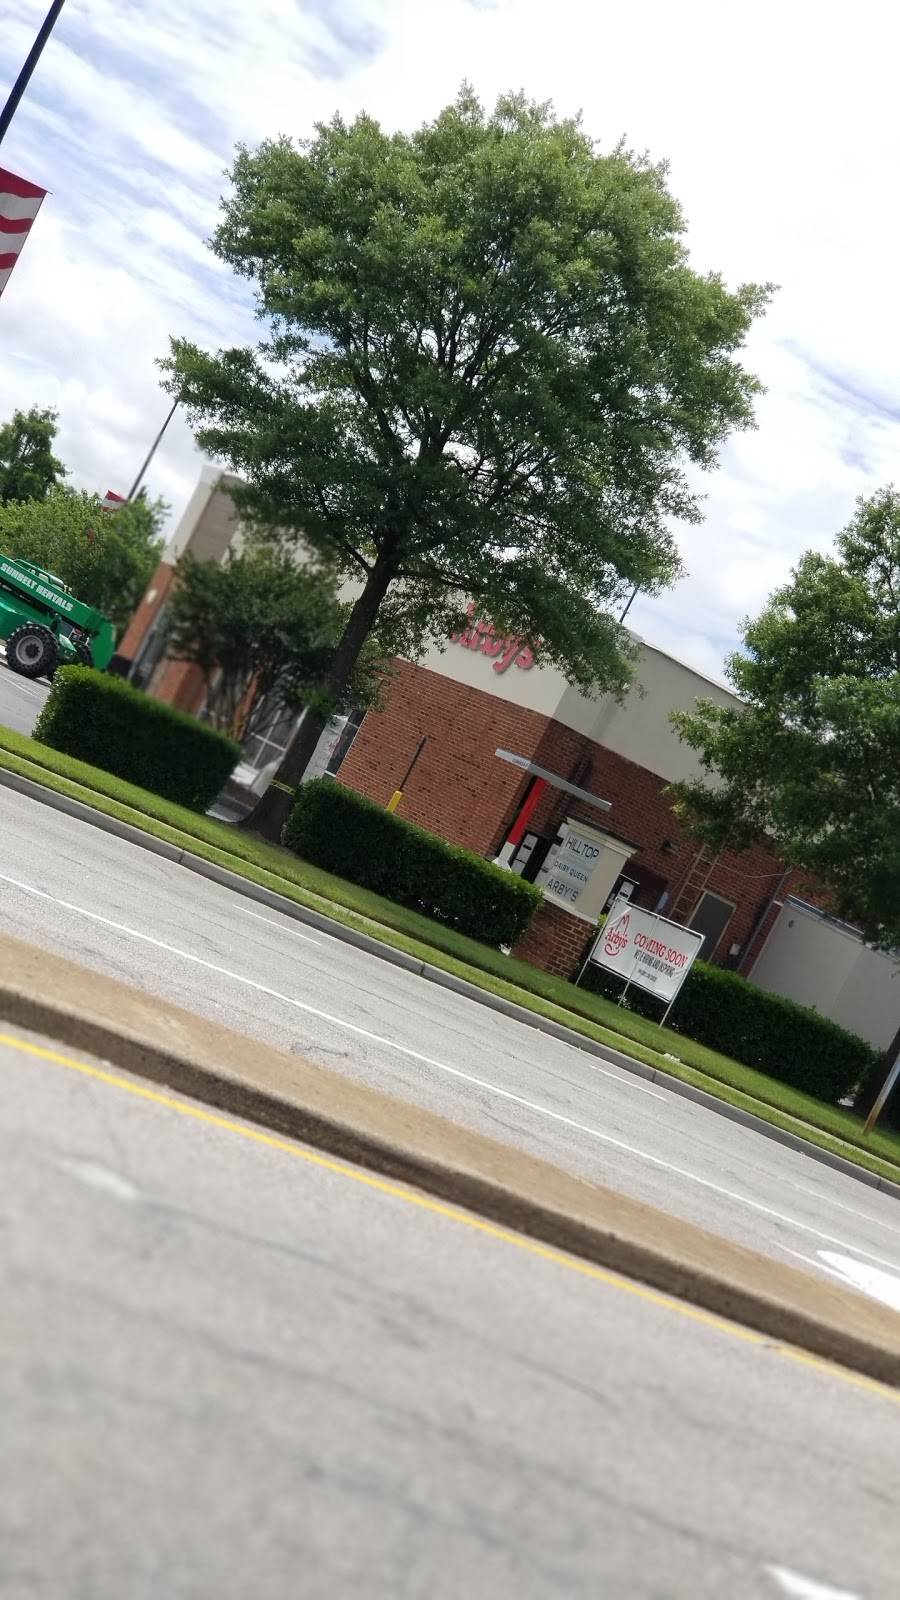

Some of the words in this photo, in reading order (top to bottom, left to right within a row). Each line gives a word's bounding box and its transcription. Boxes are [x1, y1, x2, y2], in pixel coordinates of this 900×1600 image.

[0, 562, 38, 590] SUNBELT
[36, 584, 74, 612] RENTALS
[565, 835, 600, 860] HILLTOP
[553, 860, 570, 874] DAIRY
[568, 867, 588, 883] QUEEN
[545, 878, 579, 903] ARBY'S
[633, 932, 666, 958] COMING
[664, 946, 688, 968] SOON
